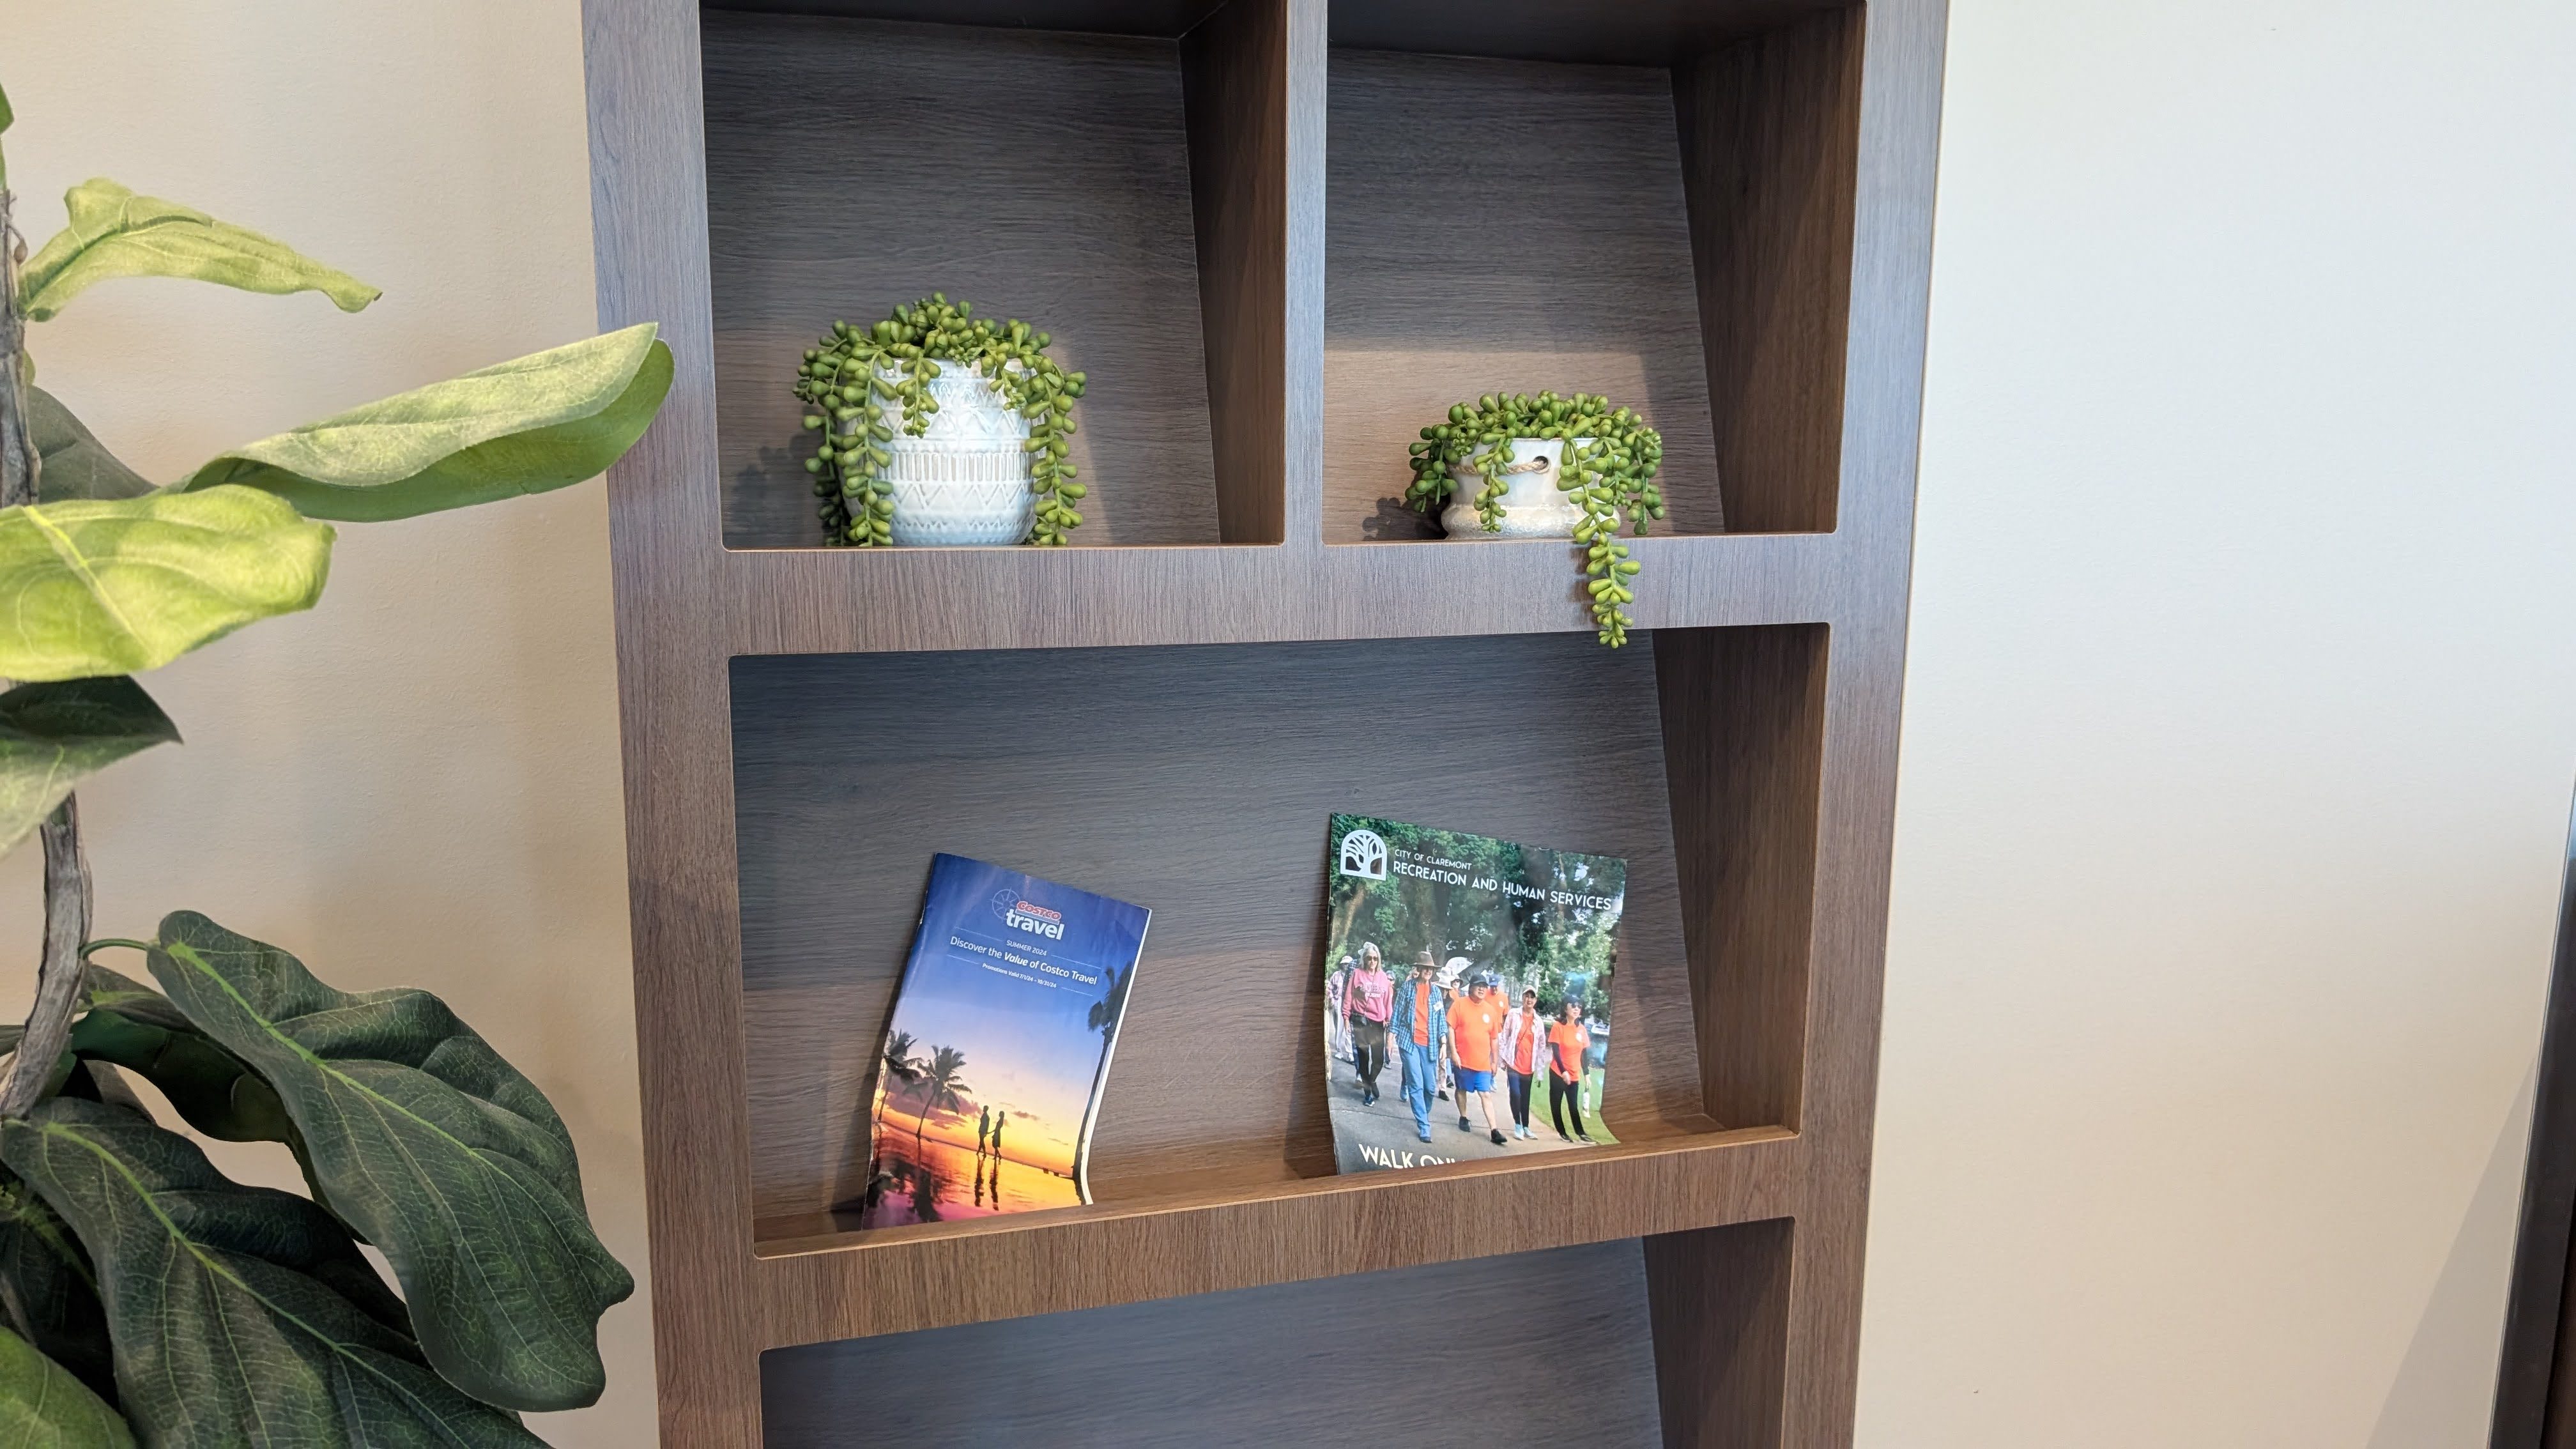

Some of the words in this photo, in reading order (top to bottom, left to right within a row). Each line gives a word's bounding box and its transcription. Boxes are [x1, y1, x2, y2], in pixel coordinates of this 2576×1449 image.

[1395, 849, 1412, 859] CITY
[1414, 852, 1425, 861] OF
[1427, 853, 1472, 871] CLAREMONT
[1393, 861, 1467, 886] RECREATION
[1471, 877, 1498, 892] AND
[1503, 882, 1545, 901] HUMAN
[1549, 890, 1612, 910] SERVICES
[1006, 908, 1065, 940] travel
[950, 936, 988, 954] Discover
[988, 947, 1002, 958] the
[1004, 952, 1029, 966] Value
[1029, 960, 1039, 969] of
[1040, 962, 1070, 977] Costco
[1071, 970, 1098, 985] Travel
[1006, 940, 1032, 951] SUMMER
[1032, 947, 1047, 956] 2024
[982, 963, 1008, 975] Promotions
[1358, 1143, 1414, 1169] WALK
